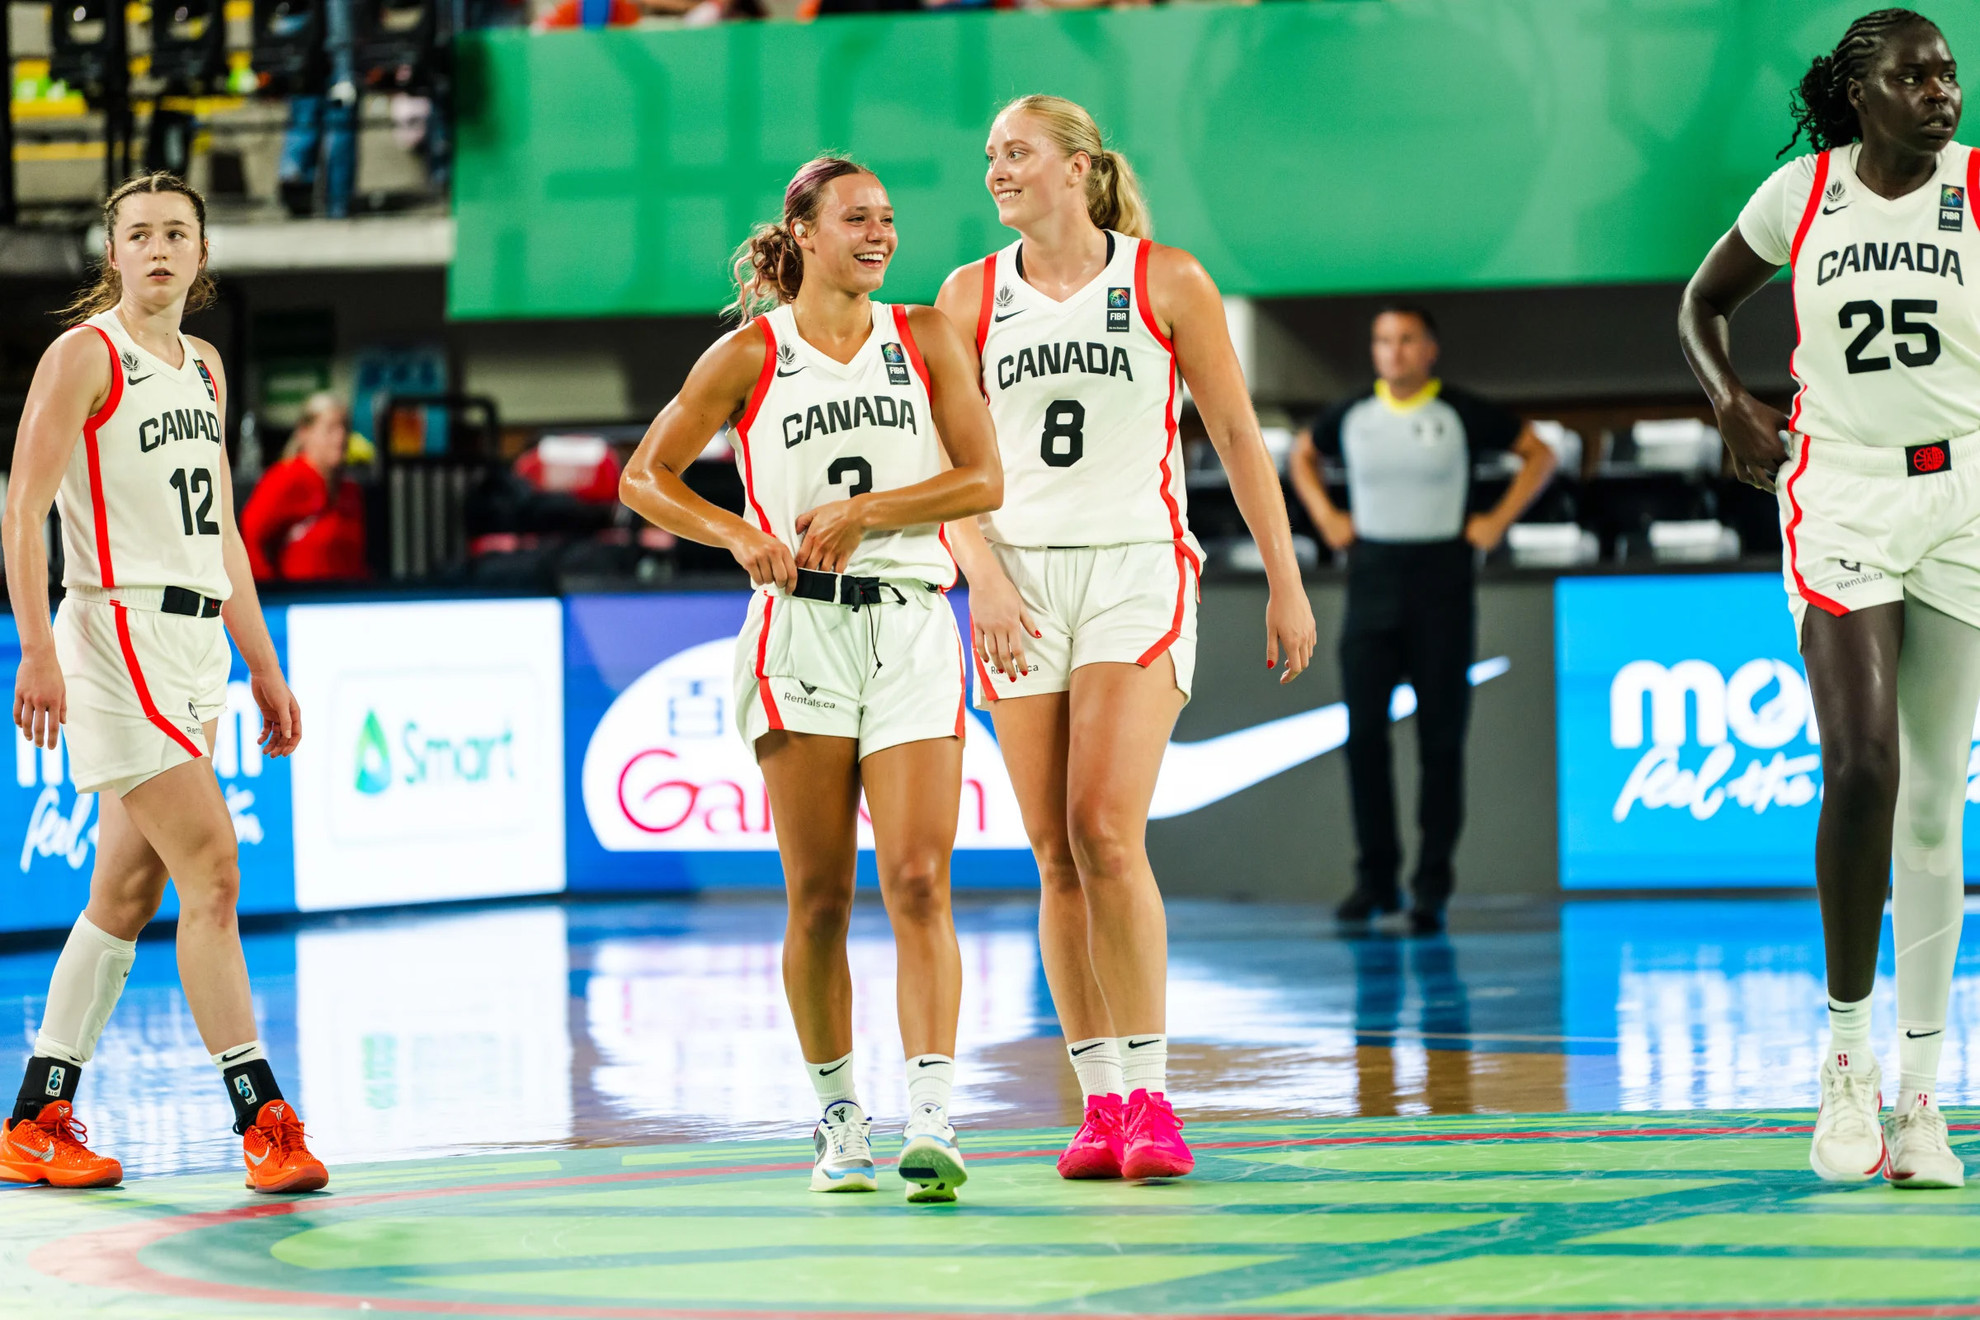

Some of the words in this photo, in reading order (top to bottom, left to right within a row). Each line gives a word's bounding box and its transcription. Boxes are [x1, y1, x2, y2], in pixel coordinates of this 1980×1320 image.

[1941, 210, 1960, 221] FIBA
[1817, 241, 1965, 287] CANADA
[1109, 312, 1127, 321] FIBA
[1838, 299, 1941, 374] 25
[889, 366, 906, 375] FIBA
[997, 341, 1134, 391] CANADA
[138, 408, 222, 453] CANAD
[782, 395, 917, 449] CANADA
[1040, 399, 1086, 468] 8
[169, 467, 220, 536] 12
[1836, 572, 1884, 591] Rentals.ca
[783, 692, 836, 709] Rentals.ca
[403, 720, 516, 784] Smart
